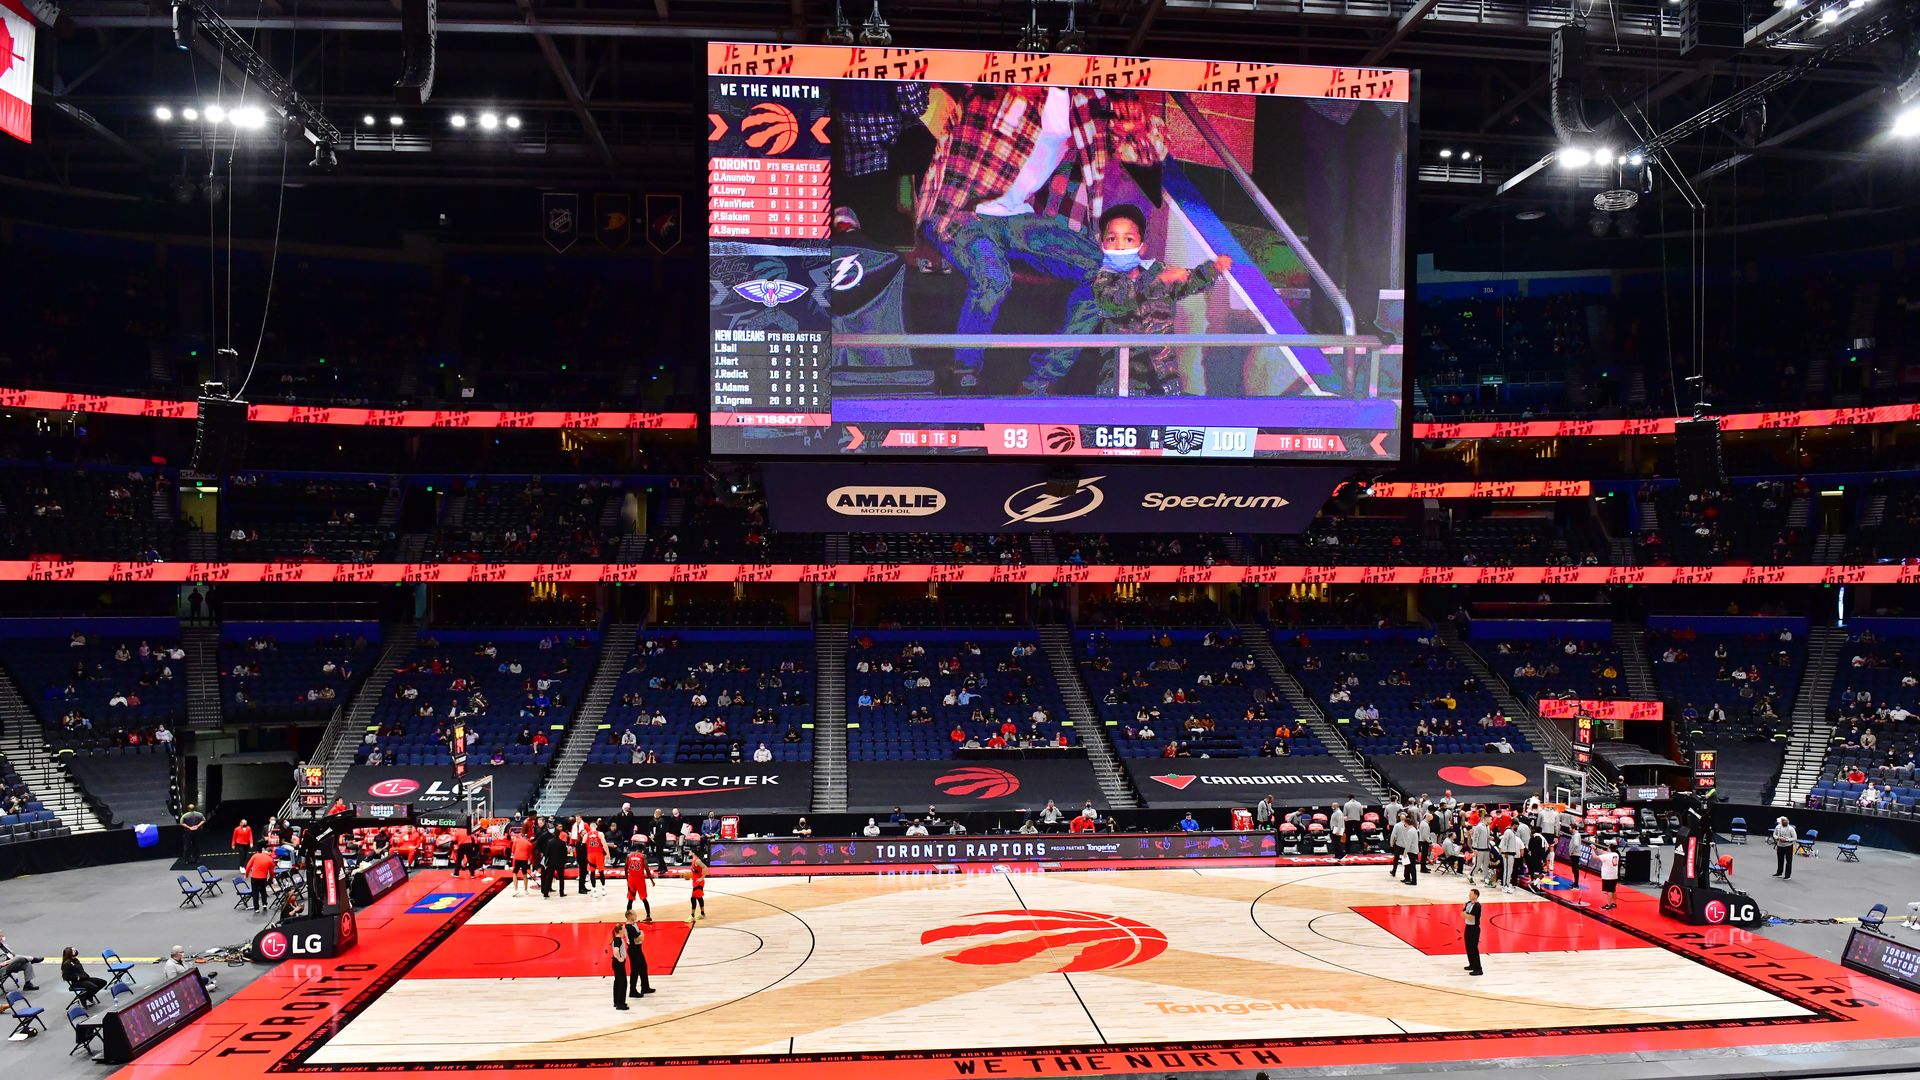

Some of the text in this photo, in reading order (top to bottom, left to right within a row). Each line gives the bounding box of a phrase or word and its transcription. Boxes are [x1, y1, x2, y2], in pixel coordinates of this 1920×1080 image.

[720, 83, 820, 99] WE THE NORTH
[713, 160, 821, 172] TORONTO PTS REB AST FLS
[785, 174, 790, 183] 7
[798, 175, 804, 183] 2
[812, 175, 818, 184] 3
[713, 185, 746, 196] K.Lowry
[785, 187, 790, 196] 1
[812, 188, 818, 197] 3
[785, 201, 790, 209] 1
[798, 201, 804, 209] 3
[812, 201, 818, 210] 3
[768, 213, 779, 222] 20
[784, 214, 790, 222] 4
[812, 214, 817, 223] 1
[769, 227, 778, 235] 11
[812, 227, 818, 236] 2
[714, 330, 821, 342] NEW ORLEANS PTS REB AST FLS
[714, 343, 737, 353] L.Ball
[785, 345, 791, 353] 4
[799, 345, 804, 353] 1
[812, 345, 818, 354] 3
[714, 356, 739, 366] J.Hart
[785, 358, 791, 366] 2
[799, 358, 804, 366] 1
[813, 358, 818, 366] 1
[714, 369, 749, 379] J.Redick
[785, 371, 791, 379] 2
[799, 371, 804, 379] 1
[812, 371, 818, 379] 3
[714, 382, 750, 392] S.Adams
[799, 384, 804, 392] 3
[813, 384, 818, 392] 1
[714, 395, 753, 406] B.Ingram
[769, 396, 780, 405] 20
[812, 397, 818, 405] 2
[756, 415, 804, 424] TISSOT
[899, 432, 917, 444] TOL
[920, 434, 927, 444] 3
[933, 433, 945, 445] TF
[950, 433, 957, 444] 3
[1003, 428, 1028, 448] 93
[1095, 427, 1137, 448] 6:56
[1151, 429, 1158, 440] 4
[1212, 431, 1334, 451] 100 TF 2 TOL 4
[836, 494, 937, 508] AMALIE
[1141, 492, 1281, 511] Spectrum
[598, 775, 780, 788] SPORTCHEK
[1200, 774, 1349, 785] CANADIAN TIRE
[438, 818, 456, 826] Eats
[876, 844, 956, 858] TORONTO
[966, 843, 1046, 857] RAPTORS
[1086, 843, 1118, 852] Tangerine
[1729, 904, 1755, 922] LG
[291, 934, 322, 954] LG
[1664, 932, 1879, 1008] RAPTORS
[1881, 954, 1919, 973] RAPTORS
[146, 990, 176, 1012] TORONTO
[1145, 997, 1348, 1015] Tangerine
[150, 1000, 180, 1022] RAPTORS
[216, 963, 378, 1057] TORONTO
[953, 1050, 1283, 1075] WE THE NORTH
